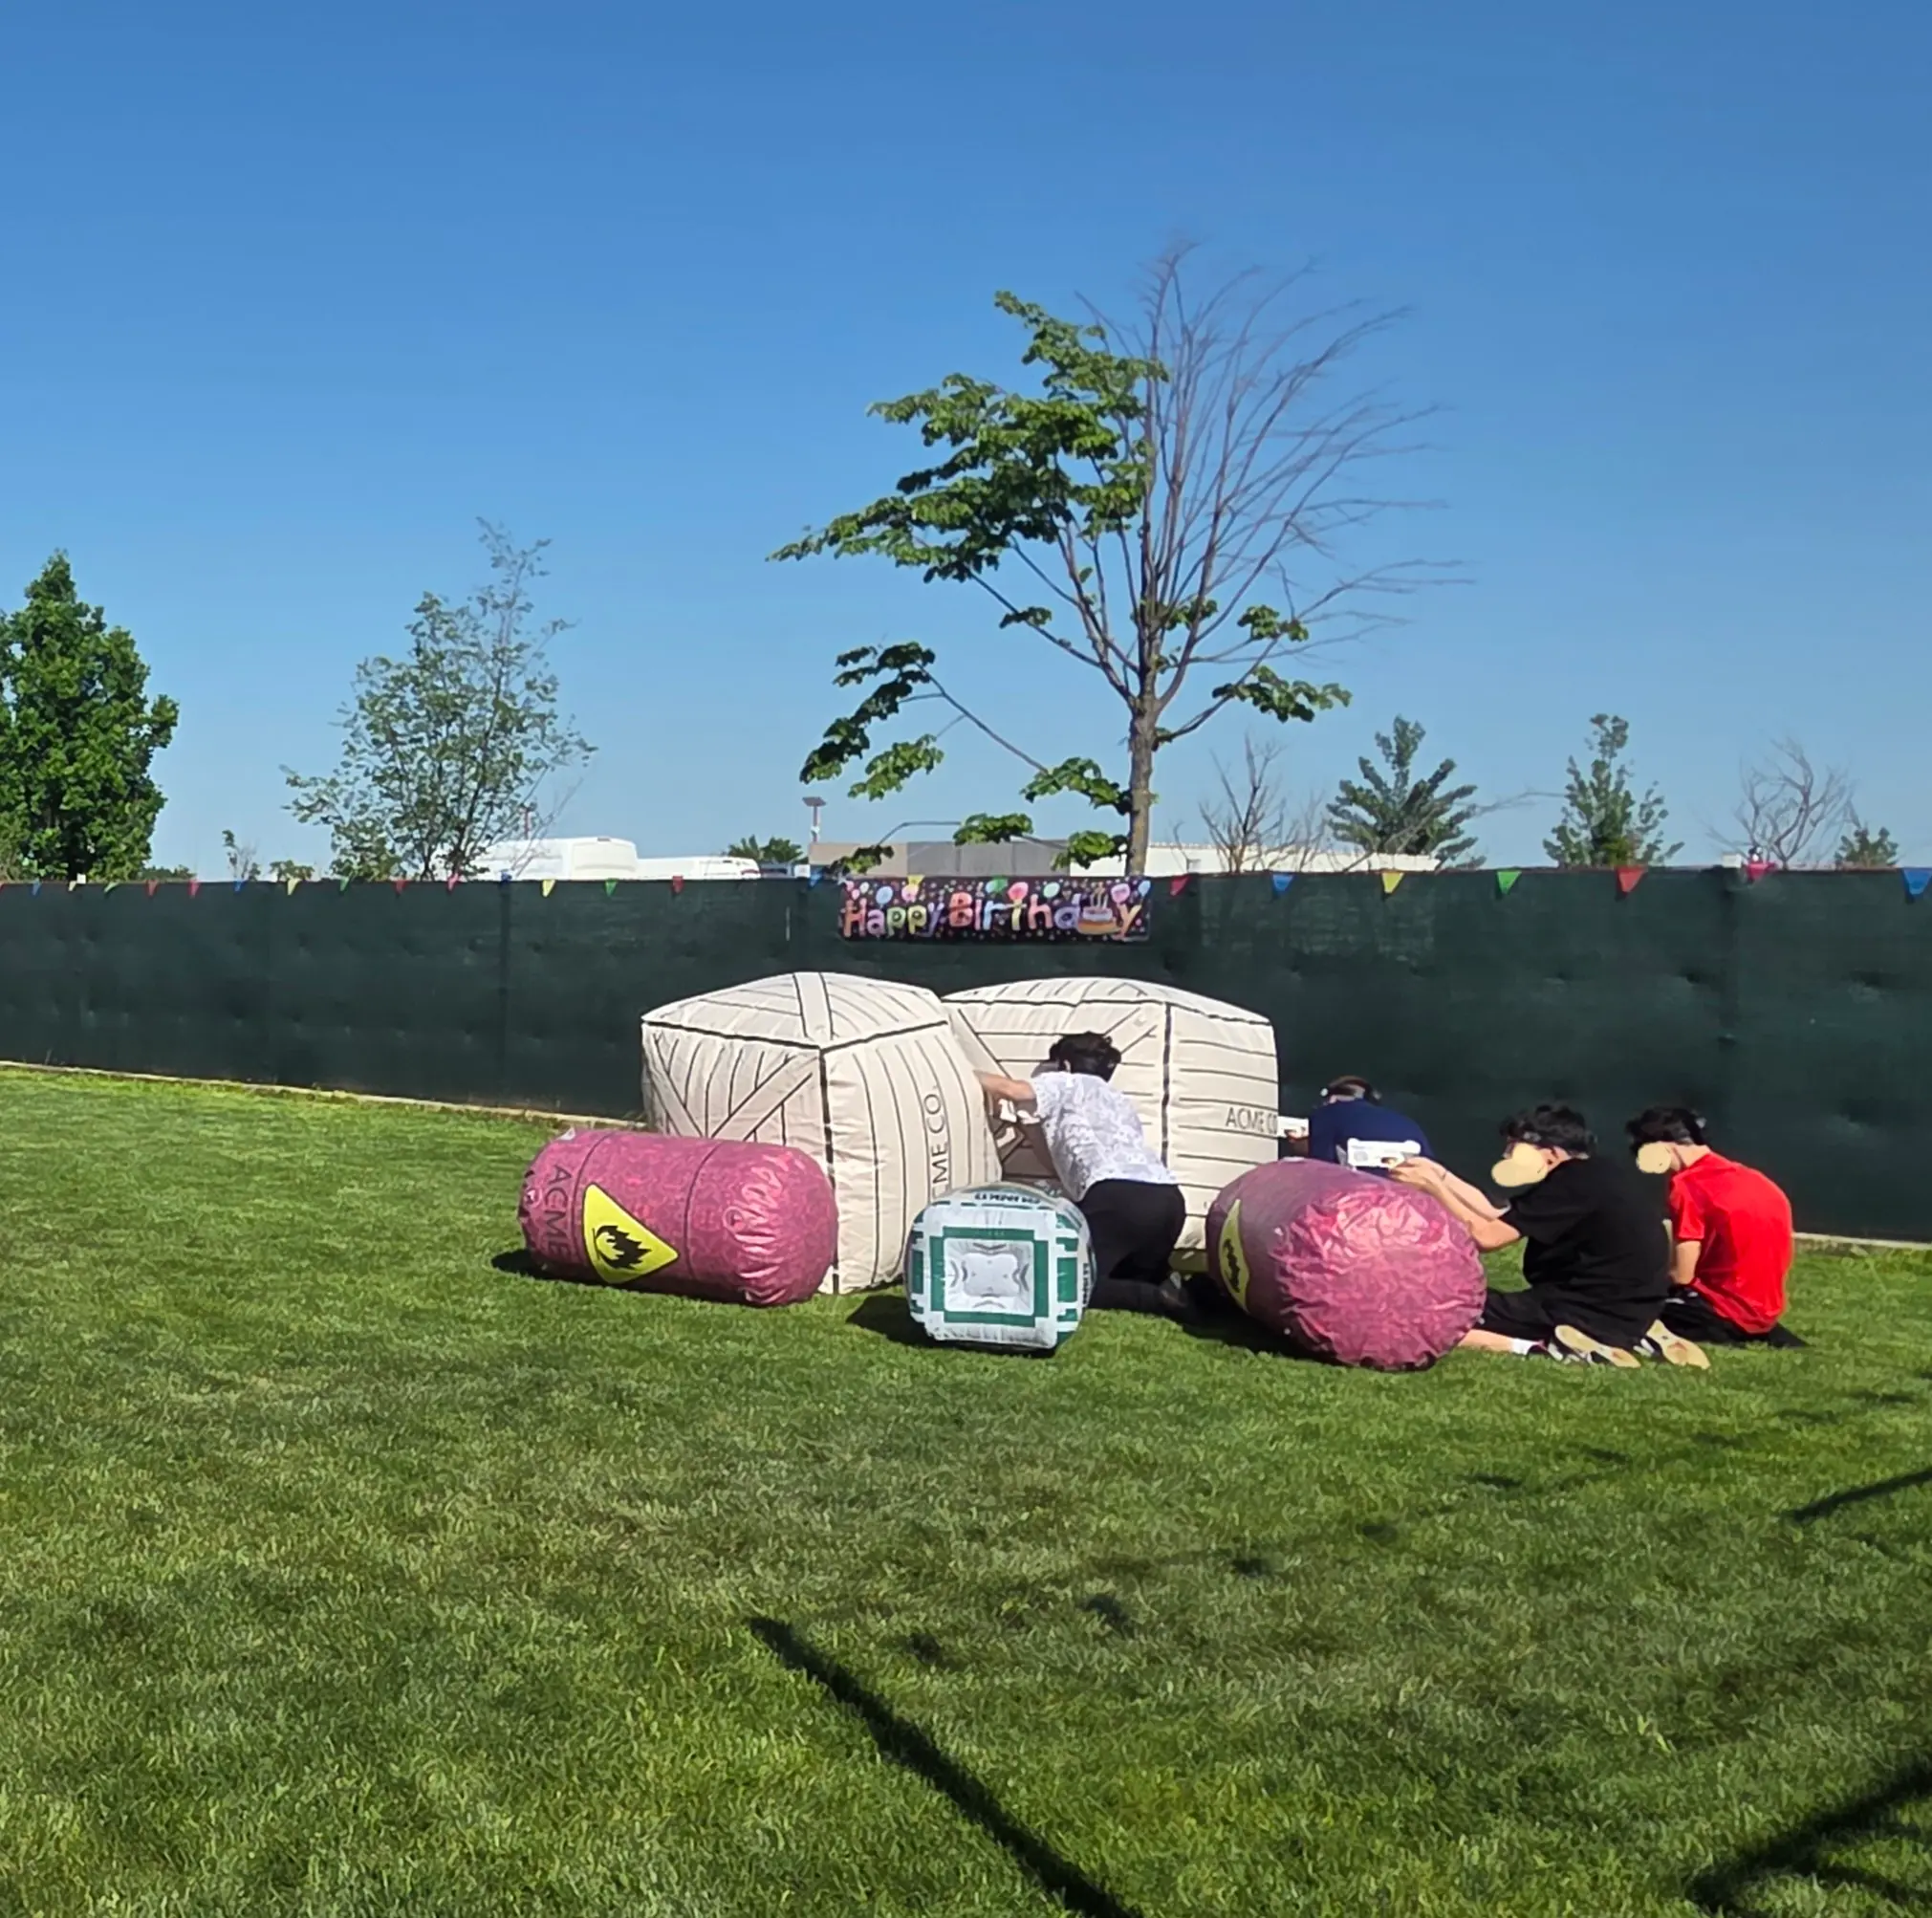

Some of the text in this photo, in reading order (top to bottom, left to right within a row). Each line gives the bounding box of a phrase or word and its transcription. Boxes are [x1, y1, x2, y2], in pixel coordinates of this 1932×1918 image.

[843, 883, 1143, 939] Happy Birthdy
[1226, 1107, 1264, 1132] ACME
[931, 1142, 948, 1199] CME
[544, 1165, 573, 1260] ACME
